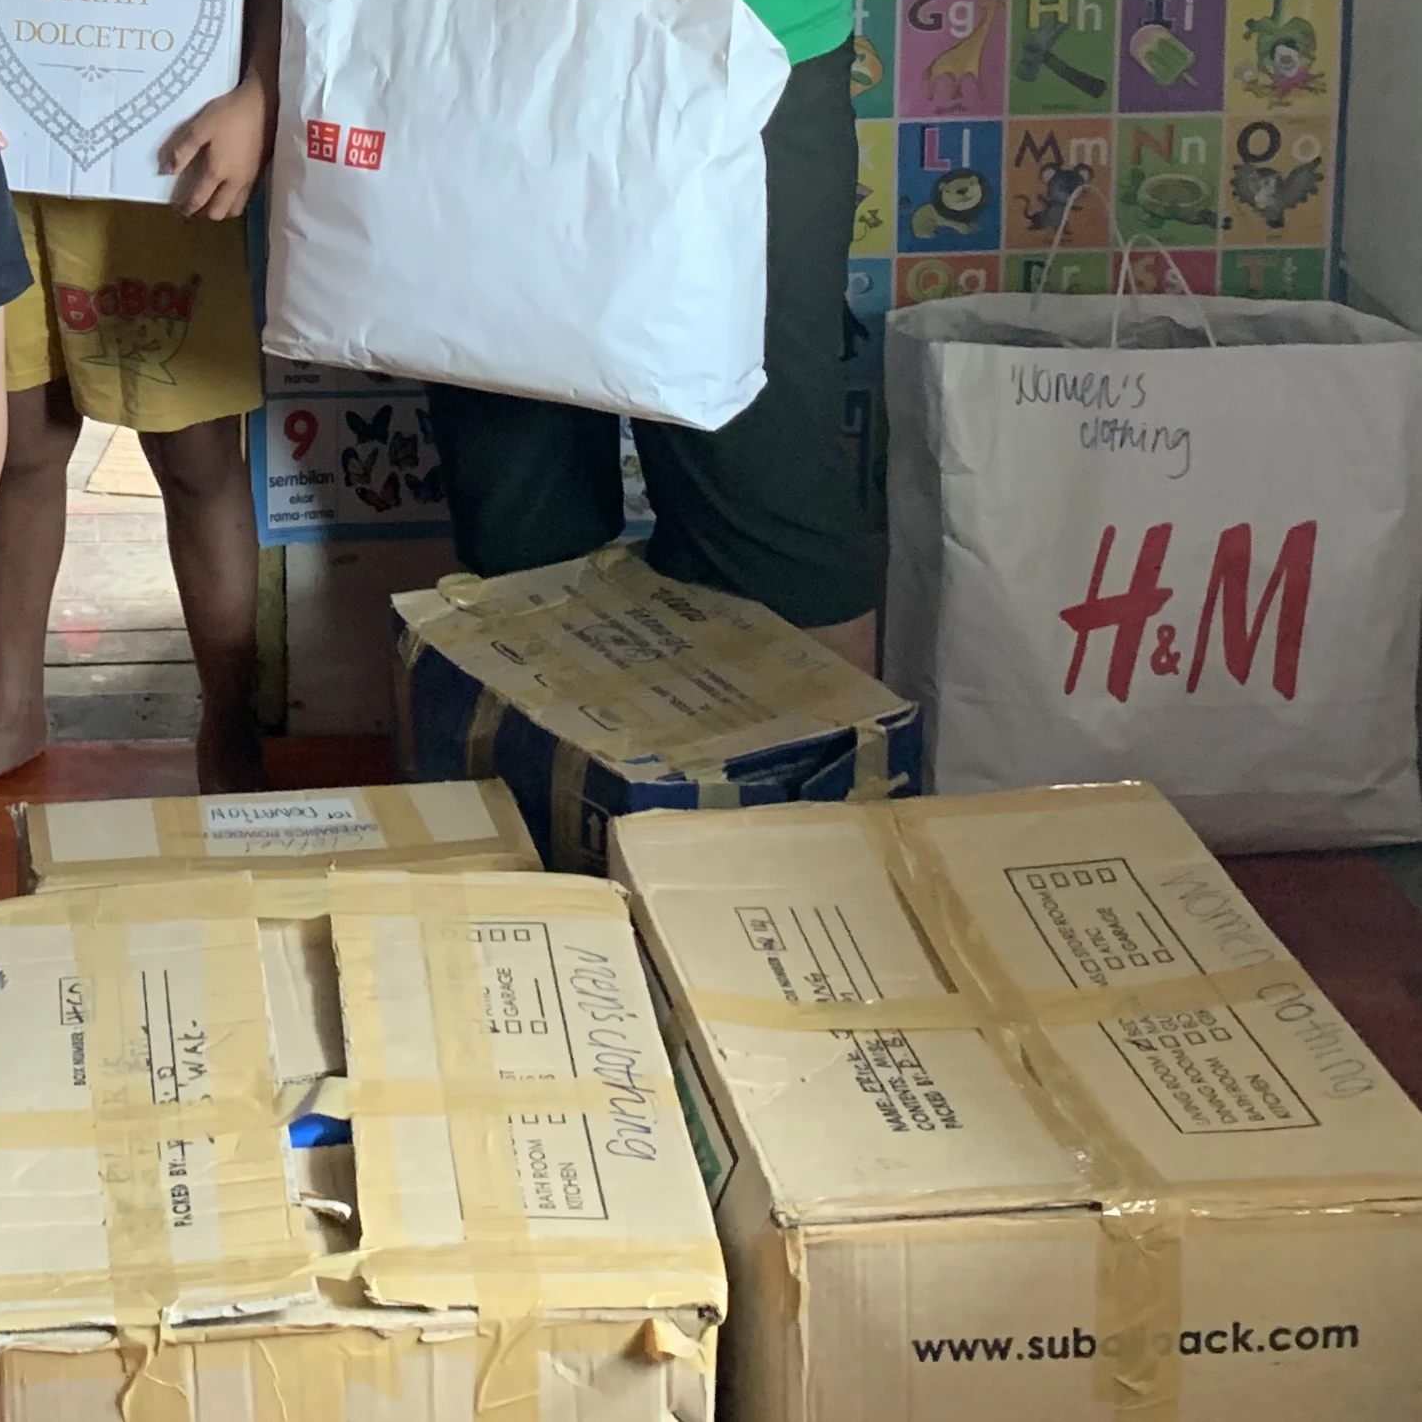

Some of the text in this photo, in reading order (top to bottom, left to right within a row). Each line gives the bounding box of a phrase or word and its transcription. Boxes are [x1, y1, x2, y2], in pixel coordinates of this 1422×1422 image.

[14, 19, 175, 54] DOLCETTO
[348, 148, 378, 166] QLO
[351, 131, 380, 150] UNI
[283, 409, 319, 462] 9
[268, 469, 335, 488] sembilan
[269, 507, 335, 522] rama-rama
[289, 492, 314, 506] ekor
[1058, 520, 1317, 702] H&M
[1097, 907, 1138, 952] GARAGE
[496, 967, 519, 1016] GARAGE
[875, 1098, 910, 1131] NAME:
[924, 1091, 963, 1129] PACKED
[1245, 1074, 1291, 1118] KITCHEN
[526, 1138, 555, 1209] BATH ROOM
[558, 1162, 583, 1209] KITCHEN
